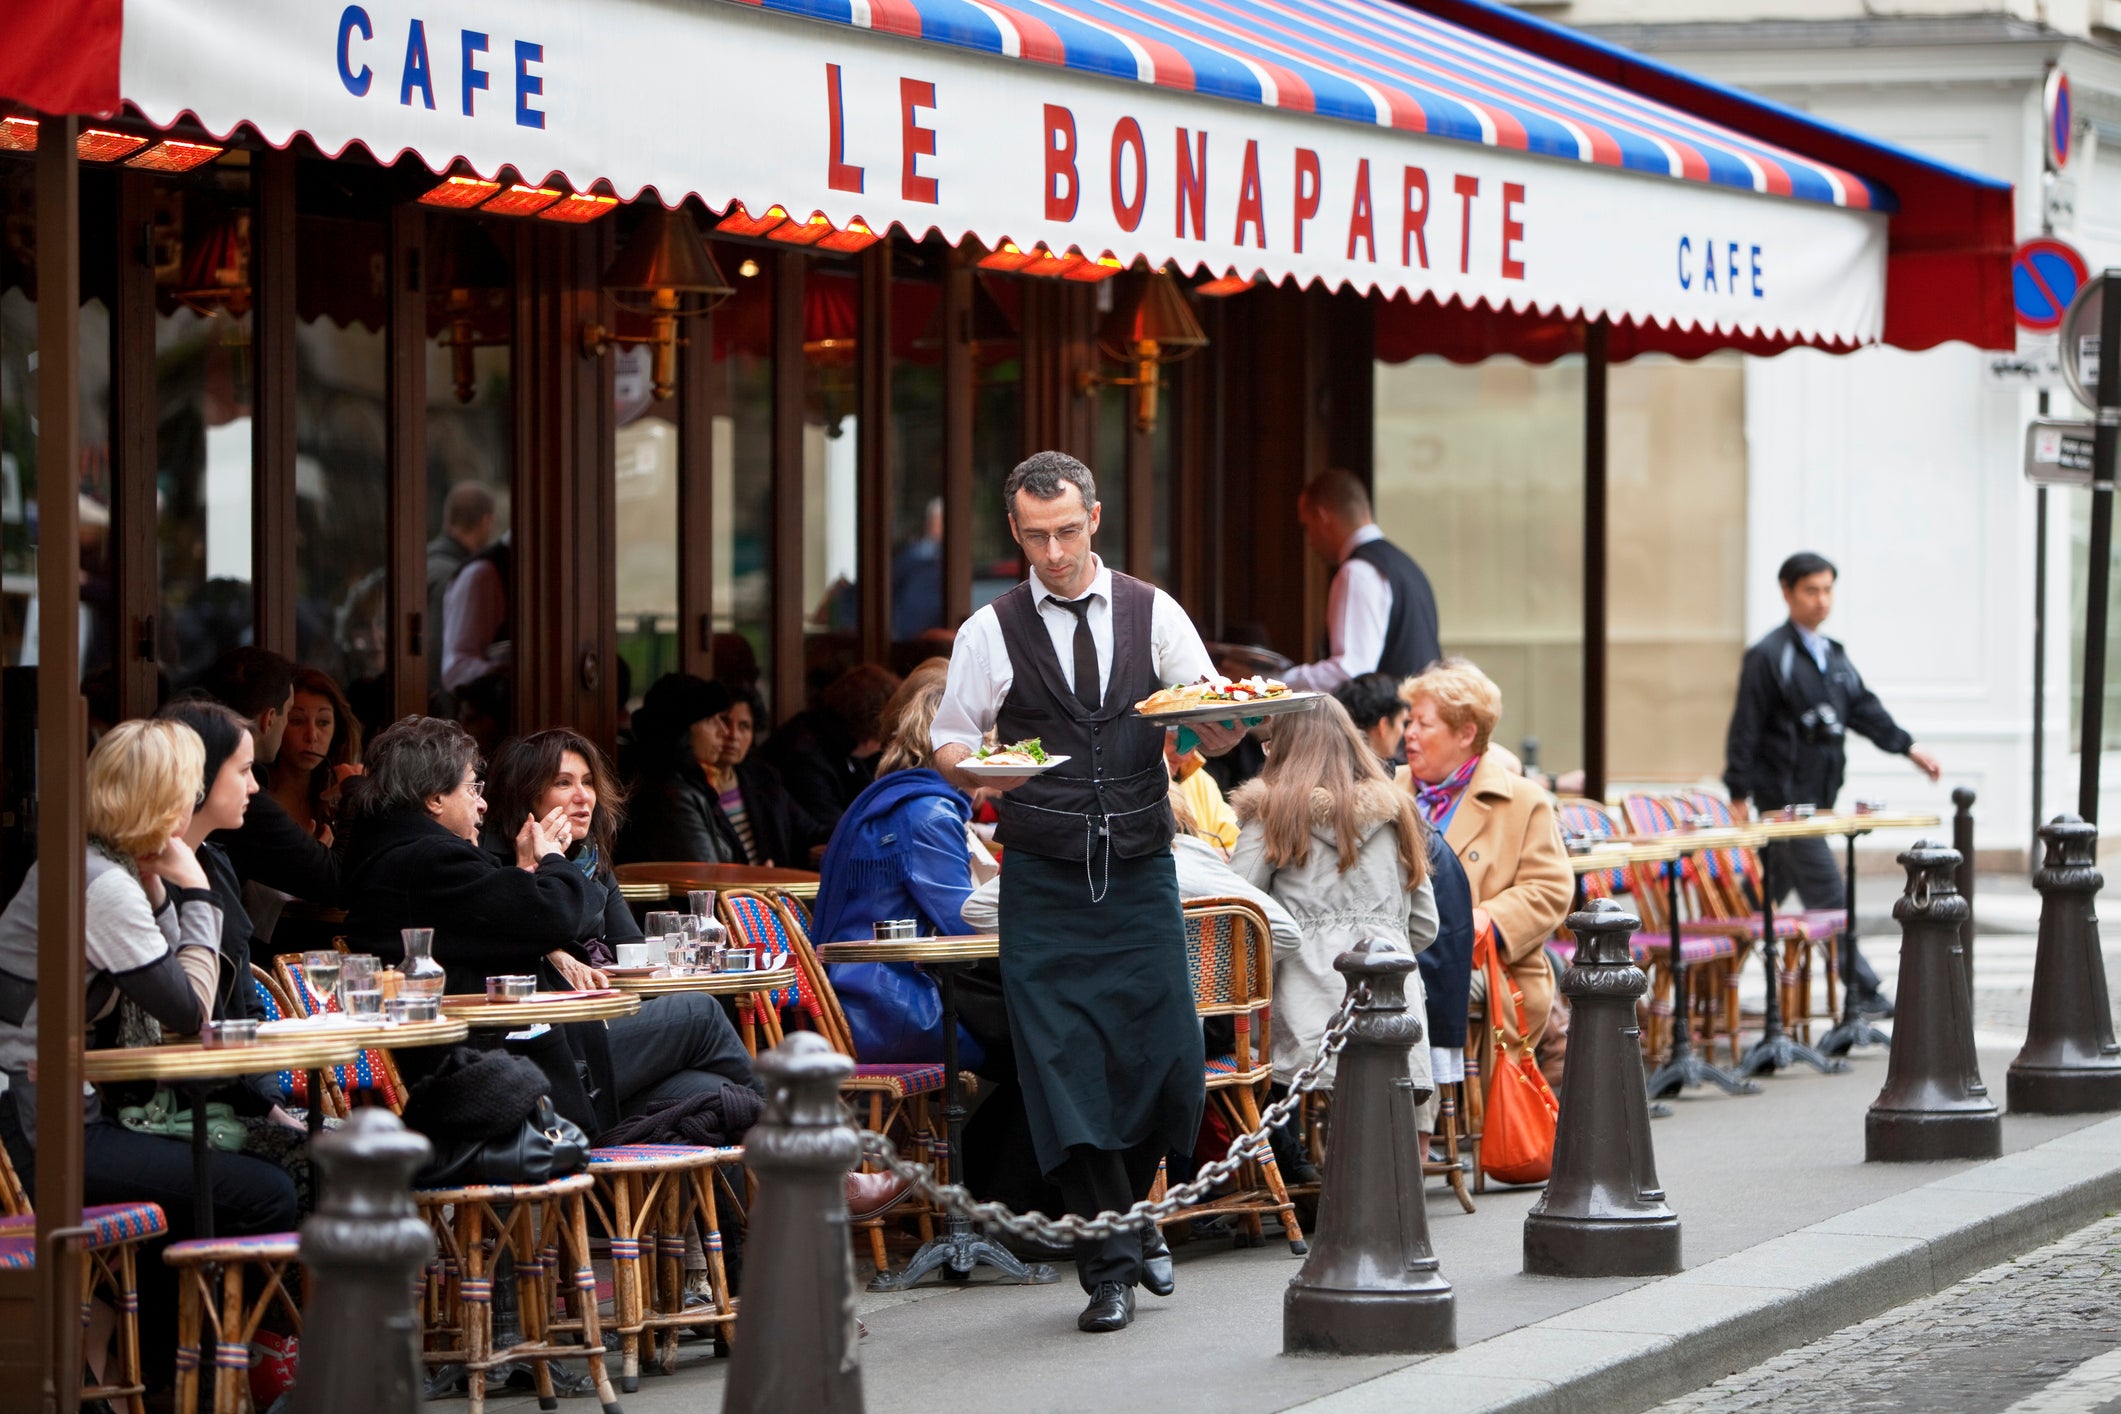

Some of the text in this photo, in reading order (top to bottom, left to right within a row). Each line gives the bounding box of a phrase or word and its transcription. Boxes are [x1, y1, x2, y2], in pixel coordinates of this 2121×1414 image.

[336, 4, 546, 129] CAFE
[825, 63, 1526, 281] LE BONAPARTE
[1678, 235, 1766, 298] CAFE
